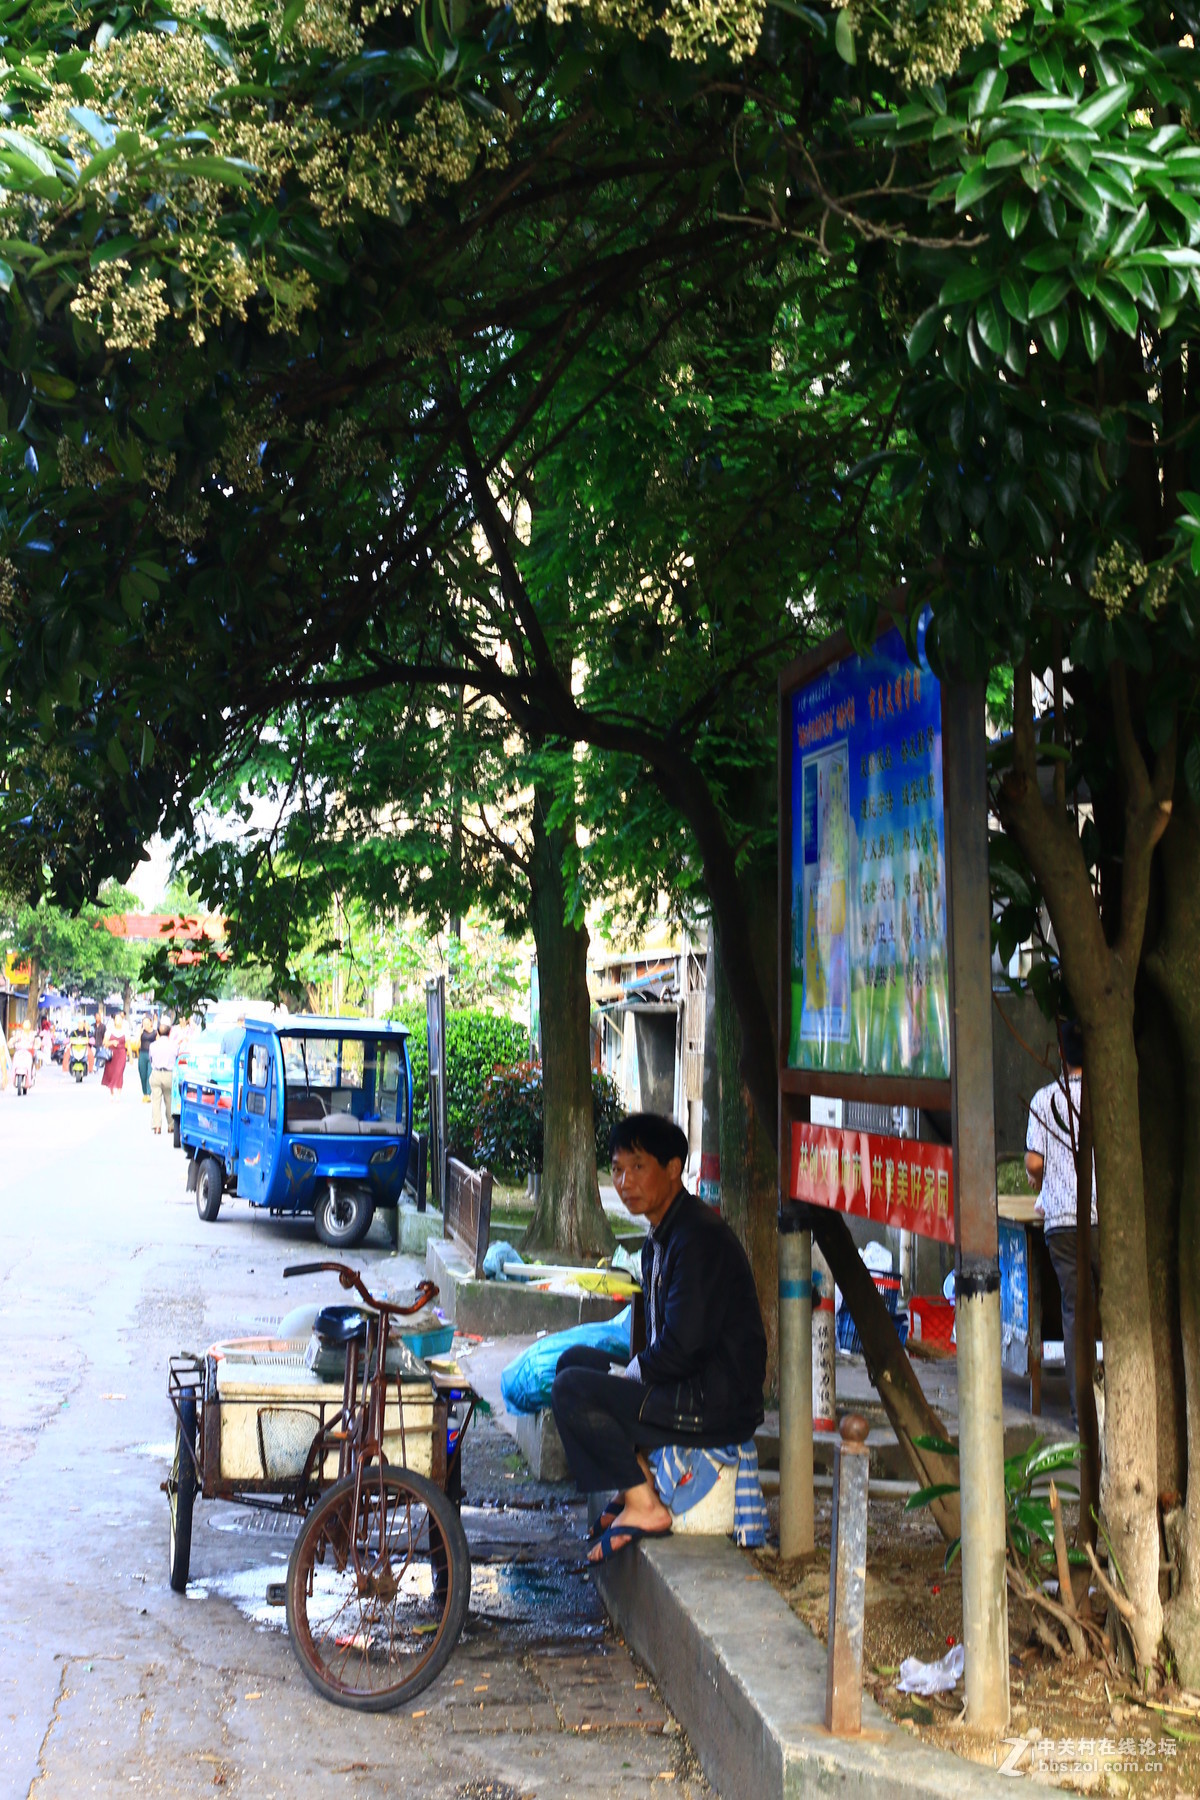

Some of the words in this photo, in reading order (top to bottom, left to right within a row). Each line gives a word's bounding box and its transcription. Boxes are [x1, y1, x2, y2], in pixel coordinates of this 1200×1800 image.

[799, 1141, 862, 1194] 共创文明城市
